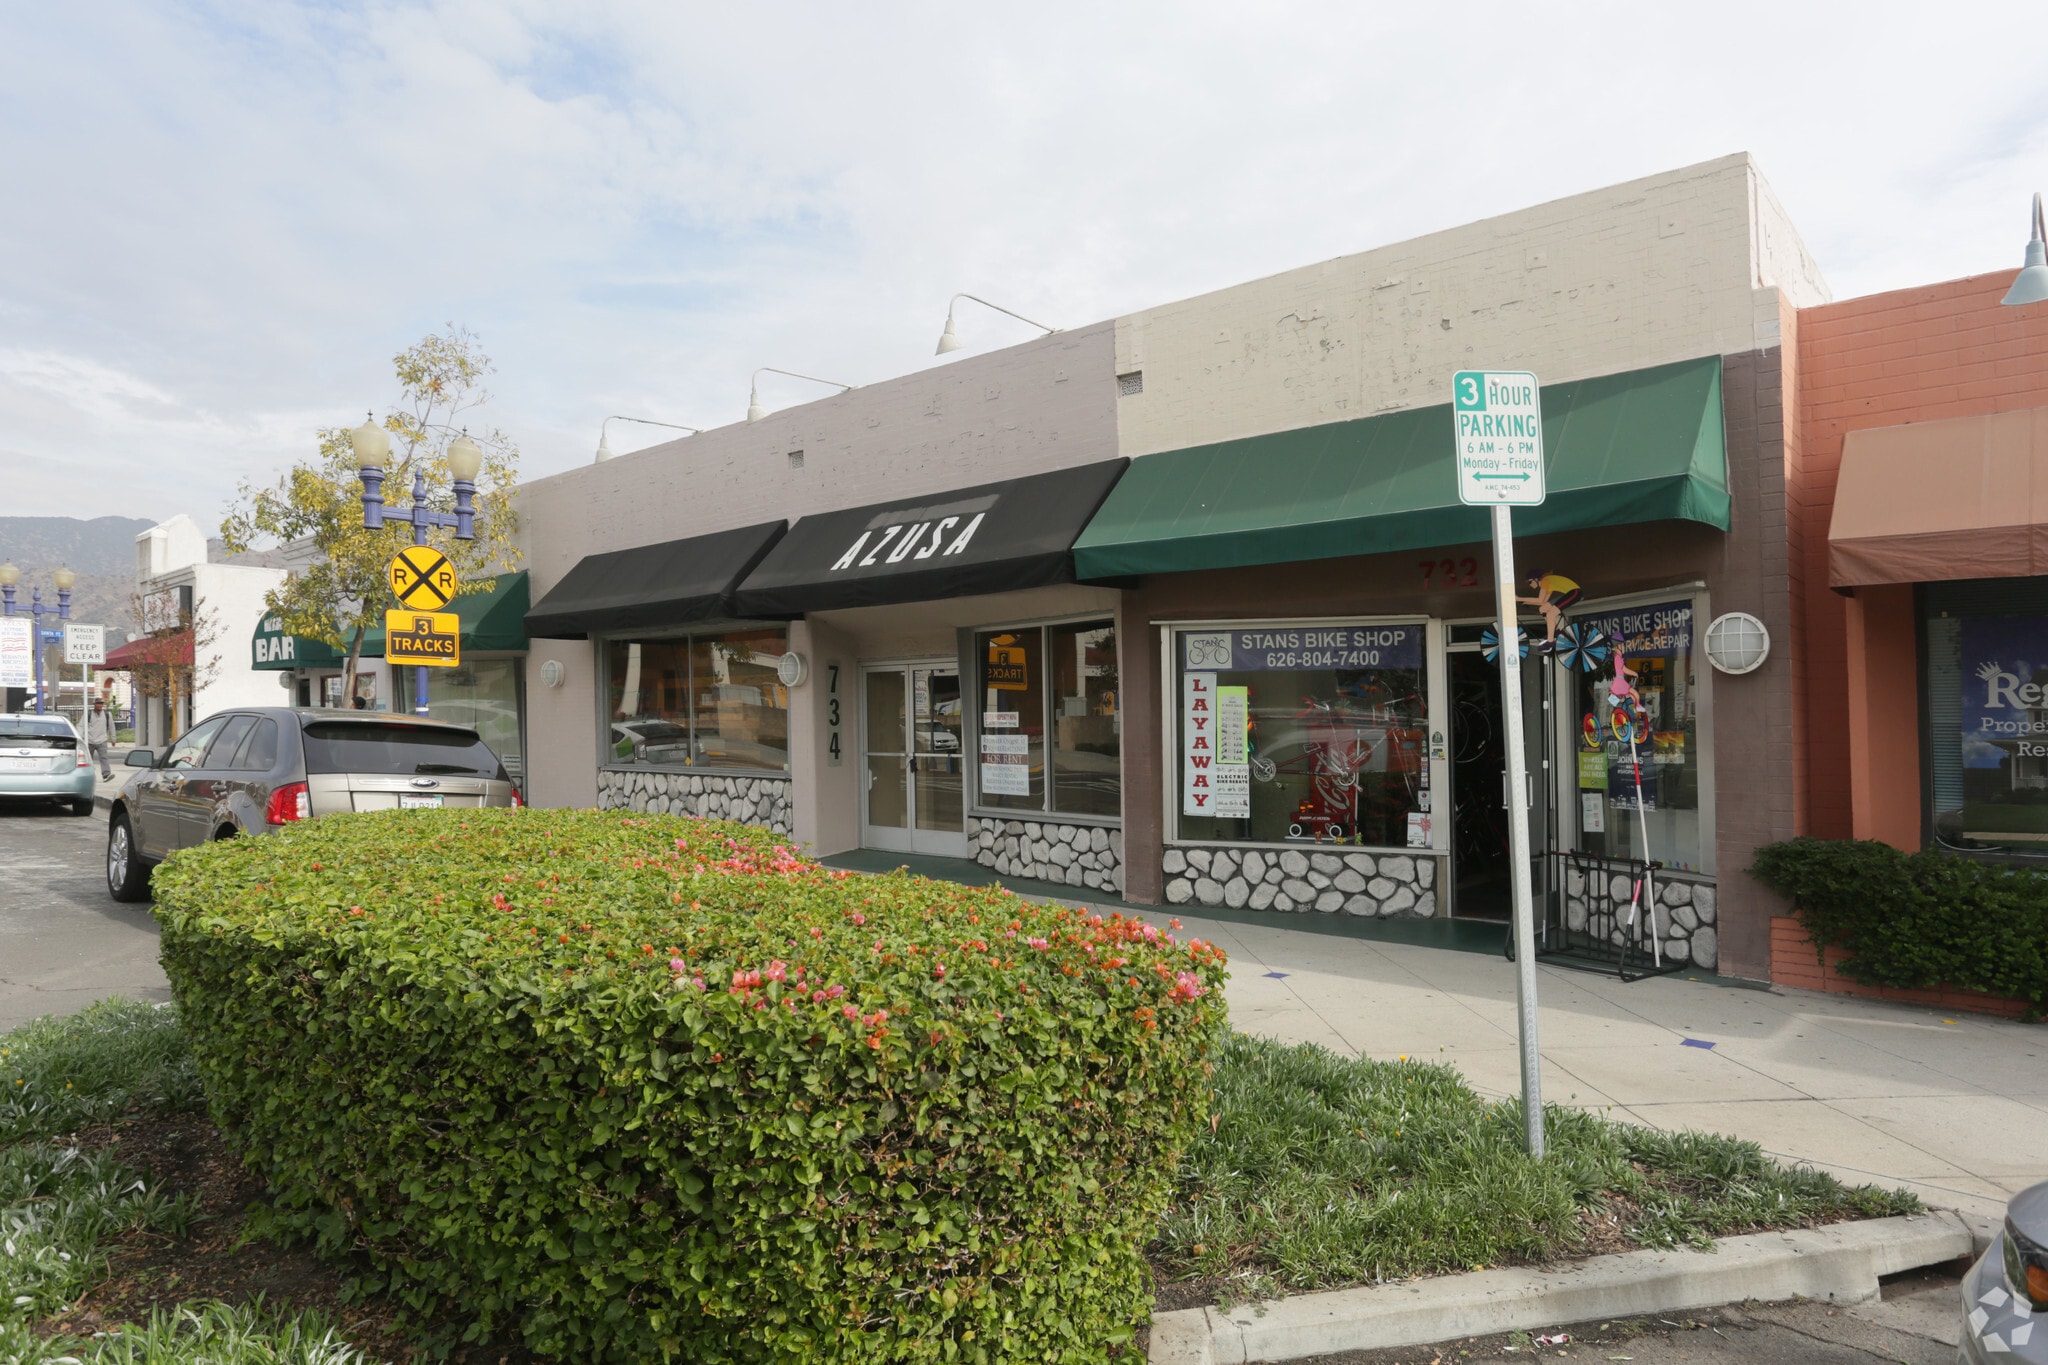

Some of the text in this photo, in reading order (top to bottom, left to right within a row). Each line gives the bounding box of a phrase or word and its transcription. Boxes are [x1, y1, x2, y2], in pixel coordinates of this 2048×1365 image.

[1460, 377, 1532, 406] 3 HOUR
[1459, 414, 1537, 437] PARKING
[1467, 442, 1474, 454] 6
[1479, 442, 1495, 454] AM
[1507, 442, 1514, 454] 6
[1519, 442, 1534, 454] PM
[1463, 457, 1500, 471] Monday
[1509, 457, 1539, 471] Friday
[830, 512, 986, 571] AZUSA
[394, 568, 452, 588] R R
[1418, 557, 1479, 591] 732
[418, 621, 429, 636] 3
[1623, 613, 1651, 634] BIKE
[1653, 608, 1691, 630] SHOP
[255, 636, 295, 663] BAR
[392, 637, 454, 653] TRACKS
[1241, 631, 1406, 649] STANS BIKE SHOP
[1266, 651, 1380, 667] 626-804-7400
[828, 665, 841, 760] 734
[1981, 717, 2048, 737] Prope
[1190, 679, 1212, 807] LAYAWAY
[2017, 741, 2048, 757] Re
[987, 754, 1023, 764] FOR RENT
